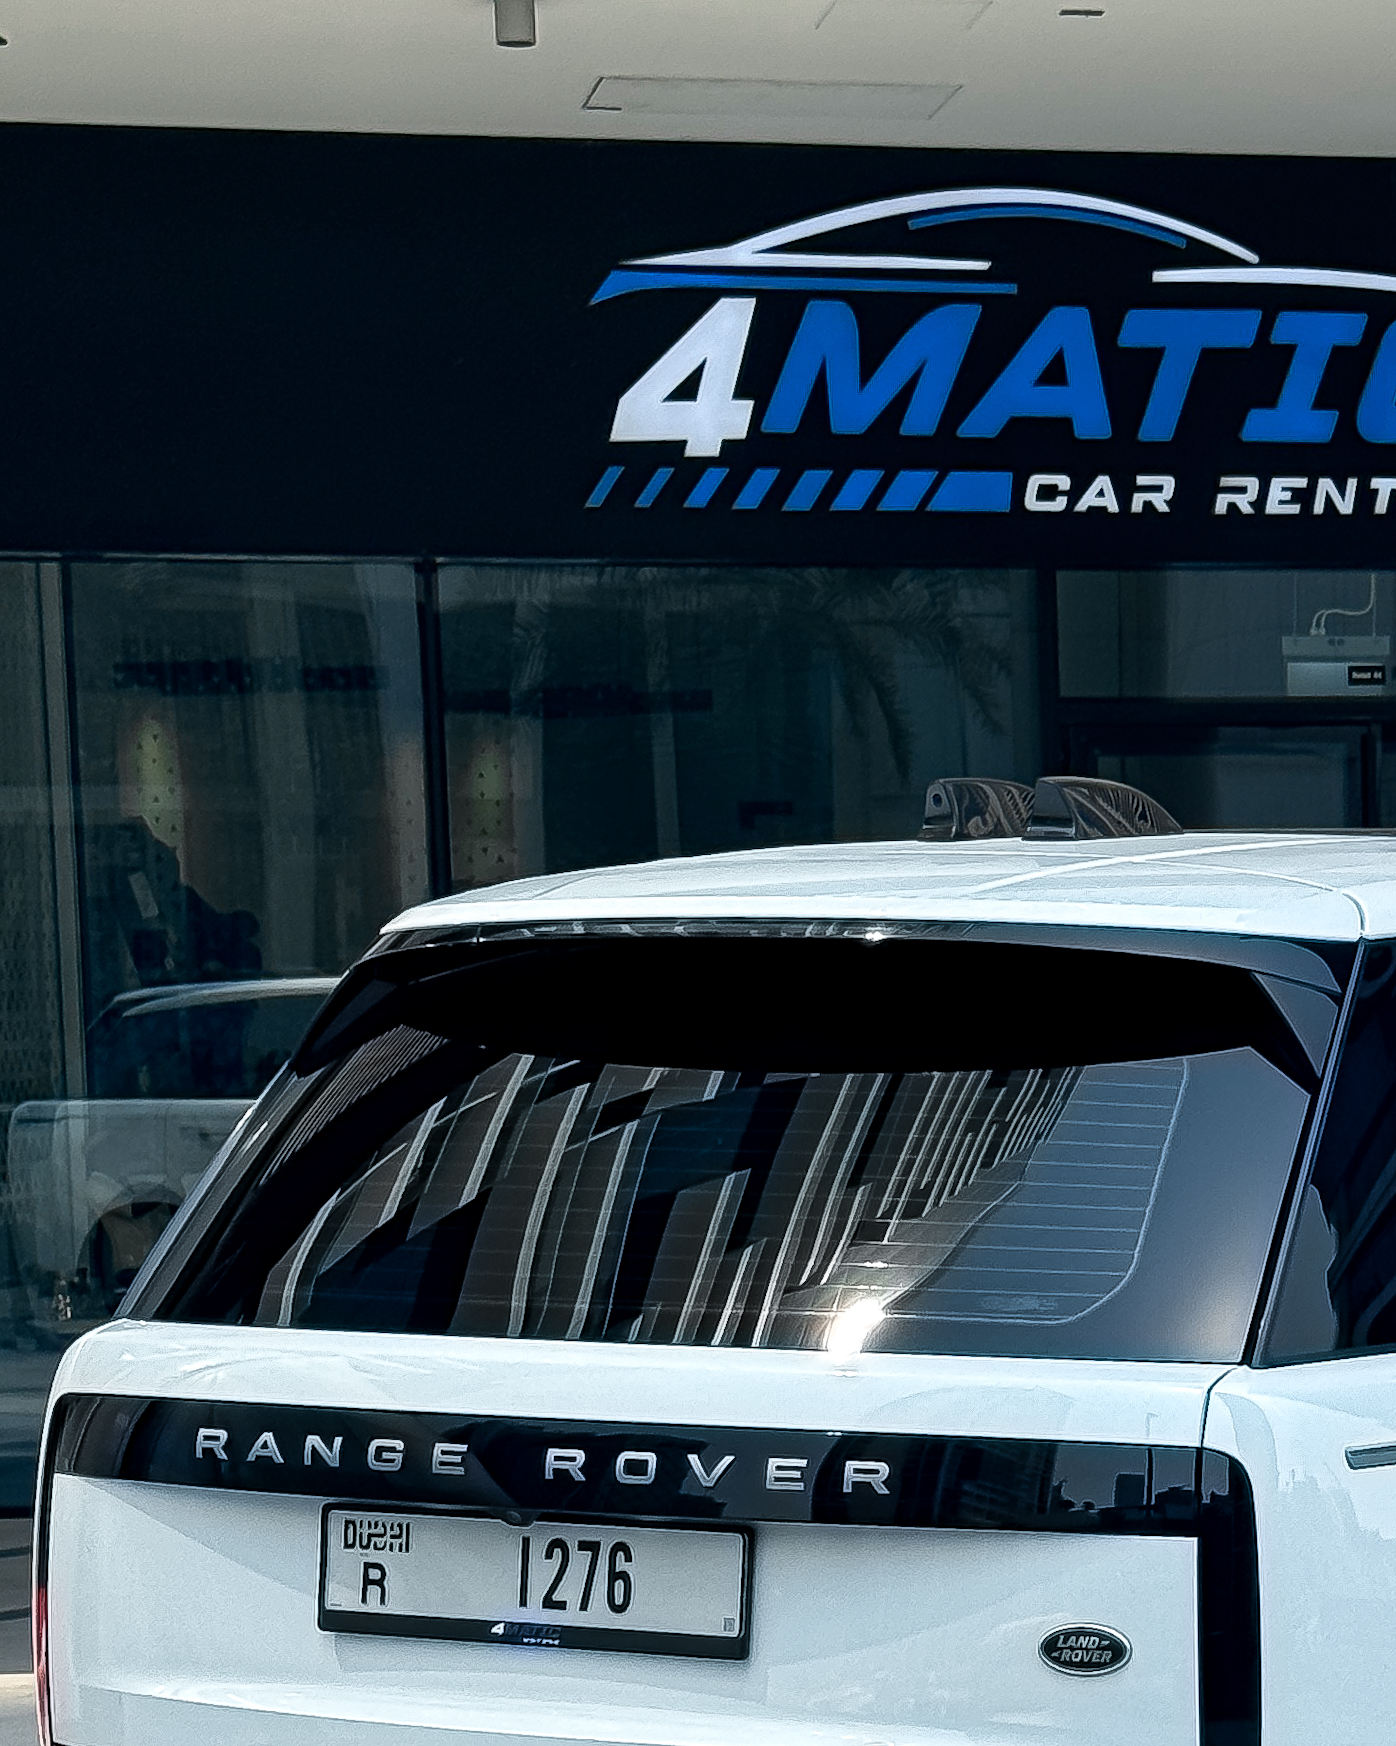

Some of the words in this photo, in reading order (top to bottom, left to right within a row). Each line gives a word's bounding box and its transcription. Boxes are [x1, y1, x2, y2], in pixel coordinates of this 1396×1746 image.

[1024, 474, 1175, 513] CAR
[195, 1426, 469, 1477] RANGE
[544, 1446, 891, 1495] ROVER
[360, 1561, 388, 1607] R
[517, 1535, 634, 1614] 1276
[1057, 1635, 1101, 1649] LAND
[1059, 1649, 1112, 1662] ROVER
